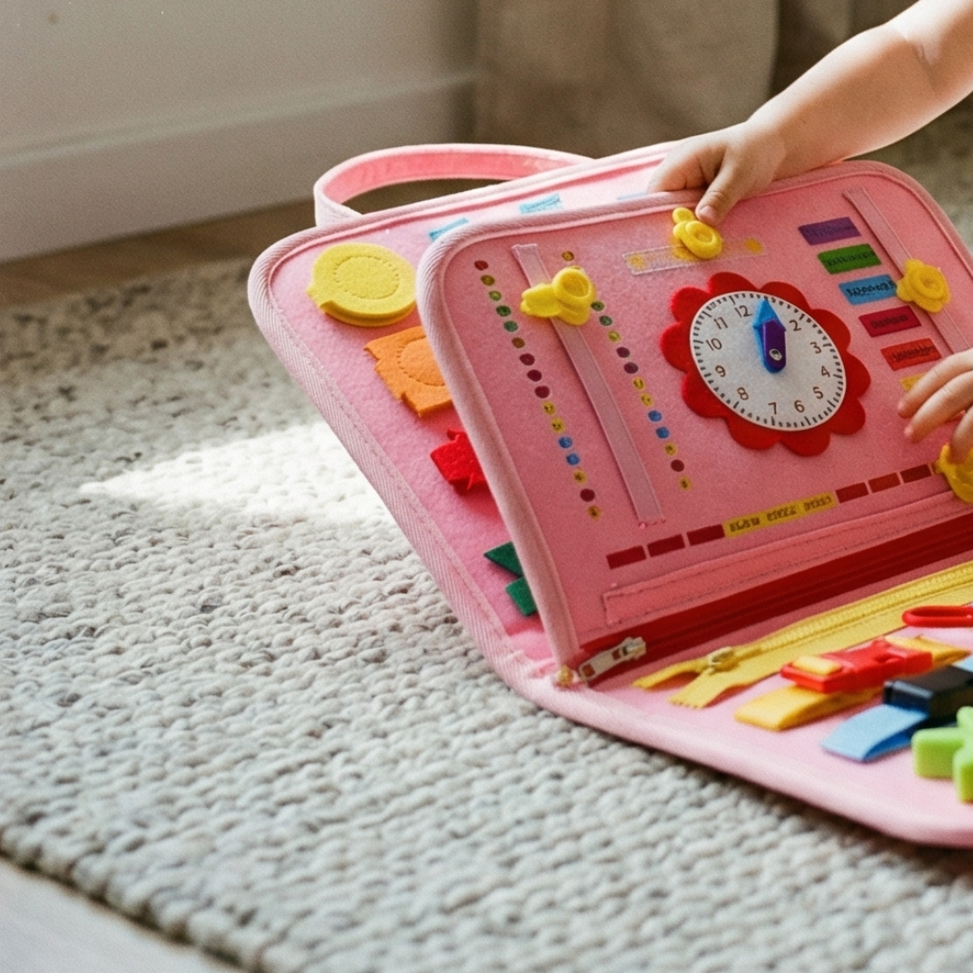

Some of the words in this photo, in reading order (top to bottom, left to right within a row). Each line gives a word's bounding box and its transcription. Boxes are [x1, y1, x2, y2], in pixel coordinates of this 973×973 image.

[734, 304, 753, 318] 12
[713, 316, 729, 330] 11
[788, 319, 802, 332] 2
[705, 337, 723, 351] 10
[809, 341, 822, 354] 3
[714, 365, 726, 378] 9
[820, 365, 831, 378] 4
[736, 386, 749, 401] 8
[812, 386, 824, 400] 5
[767, 401, 777, 415] 7
[794, 399, 805, 413] 6
